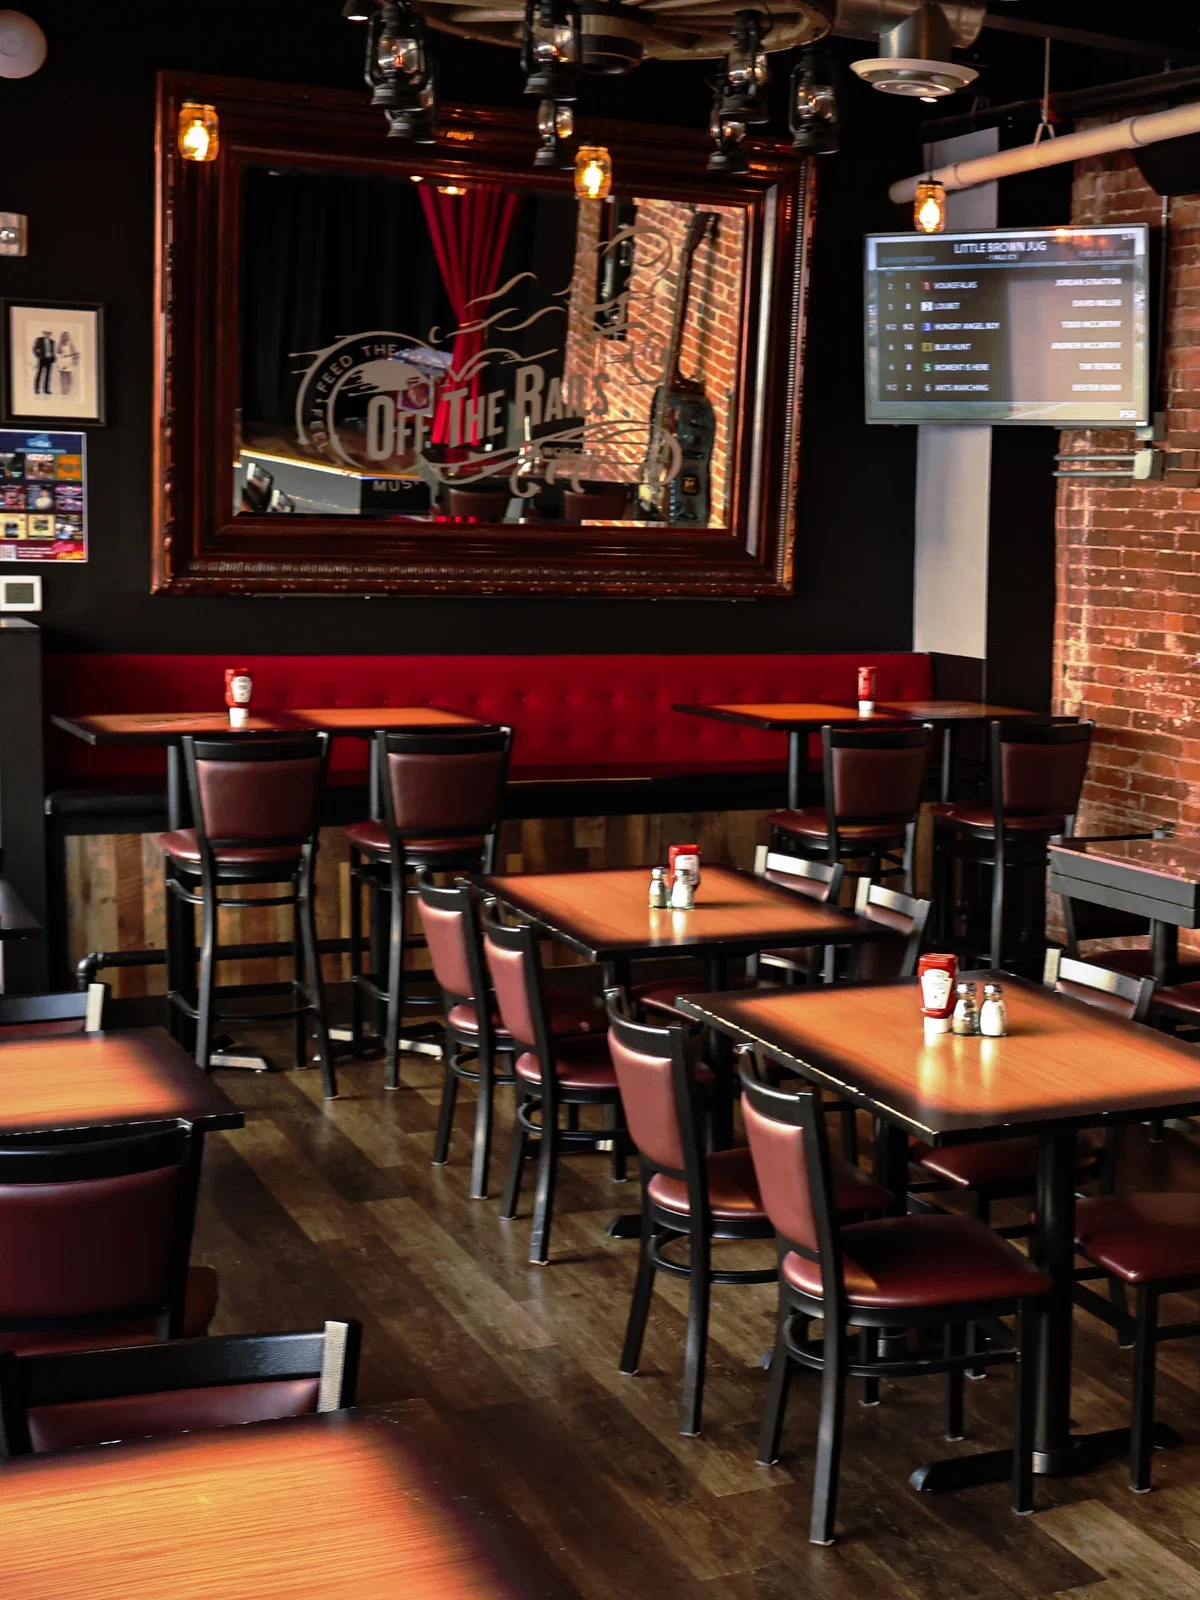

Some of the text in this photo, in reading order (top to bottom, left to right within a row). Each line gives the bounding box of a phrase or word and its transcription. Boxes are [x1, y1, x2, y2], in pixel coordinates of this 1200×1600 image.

[954, 241, 1047, 254] LITTLE BROWN JUG
[316, 344, 398, 393] FEED THE
[366, 364, 610, 460] OFF THE RAILS
[373, 479, 421, 492] MUS
